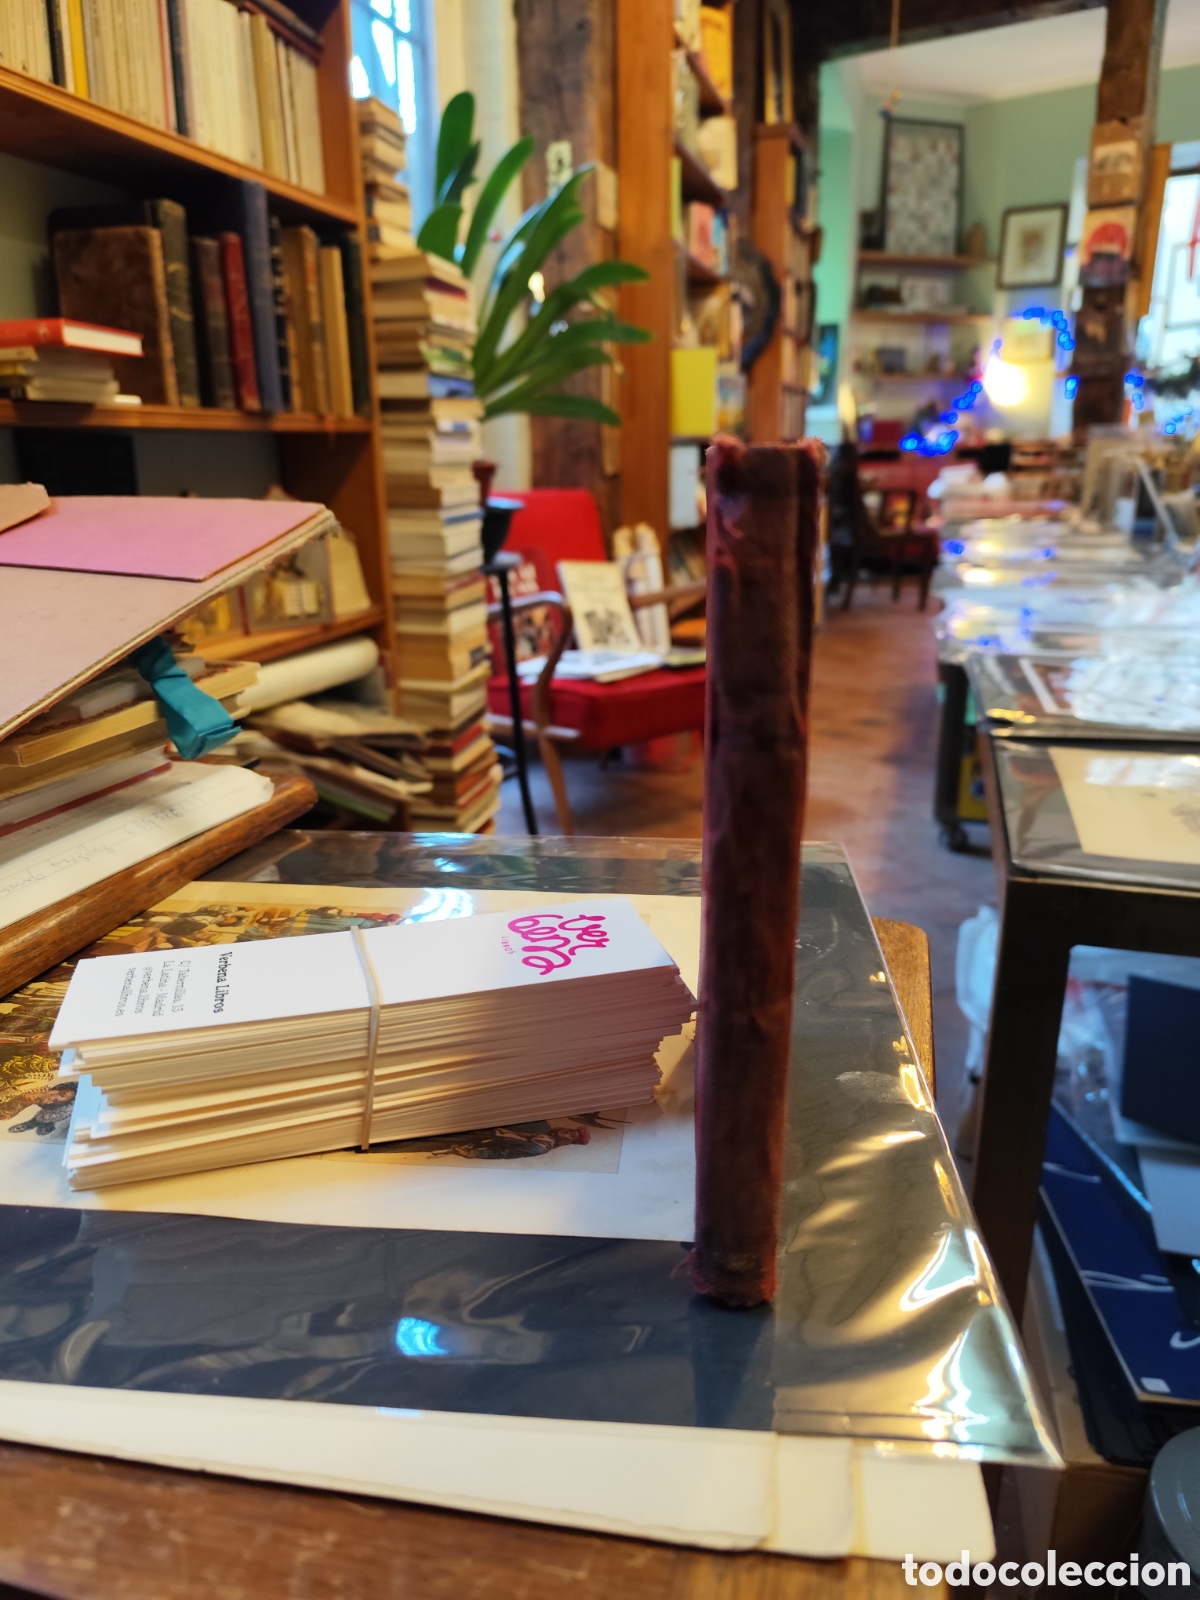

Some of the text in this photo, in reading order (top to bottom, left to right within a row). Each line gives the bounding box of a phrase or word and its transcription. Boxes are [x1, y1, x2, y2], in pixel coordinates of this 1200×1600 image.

[501, 936, 516, 955] LIBROS
[162, 960, 175, 968] La
[158, 968, 173, 988] Latina
[213, 951, 233, 1014] Verbena Libros
[152, 992, 168, 1017] Madrid
